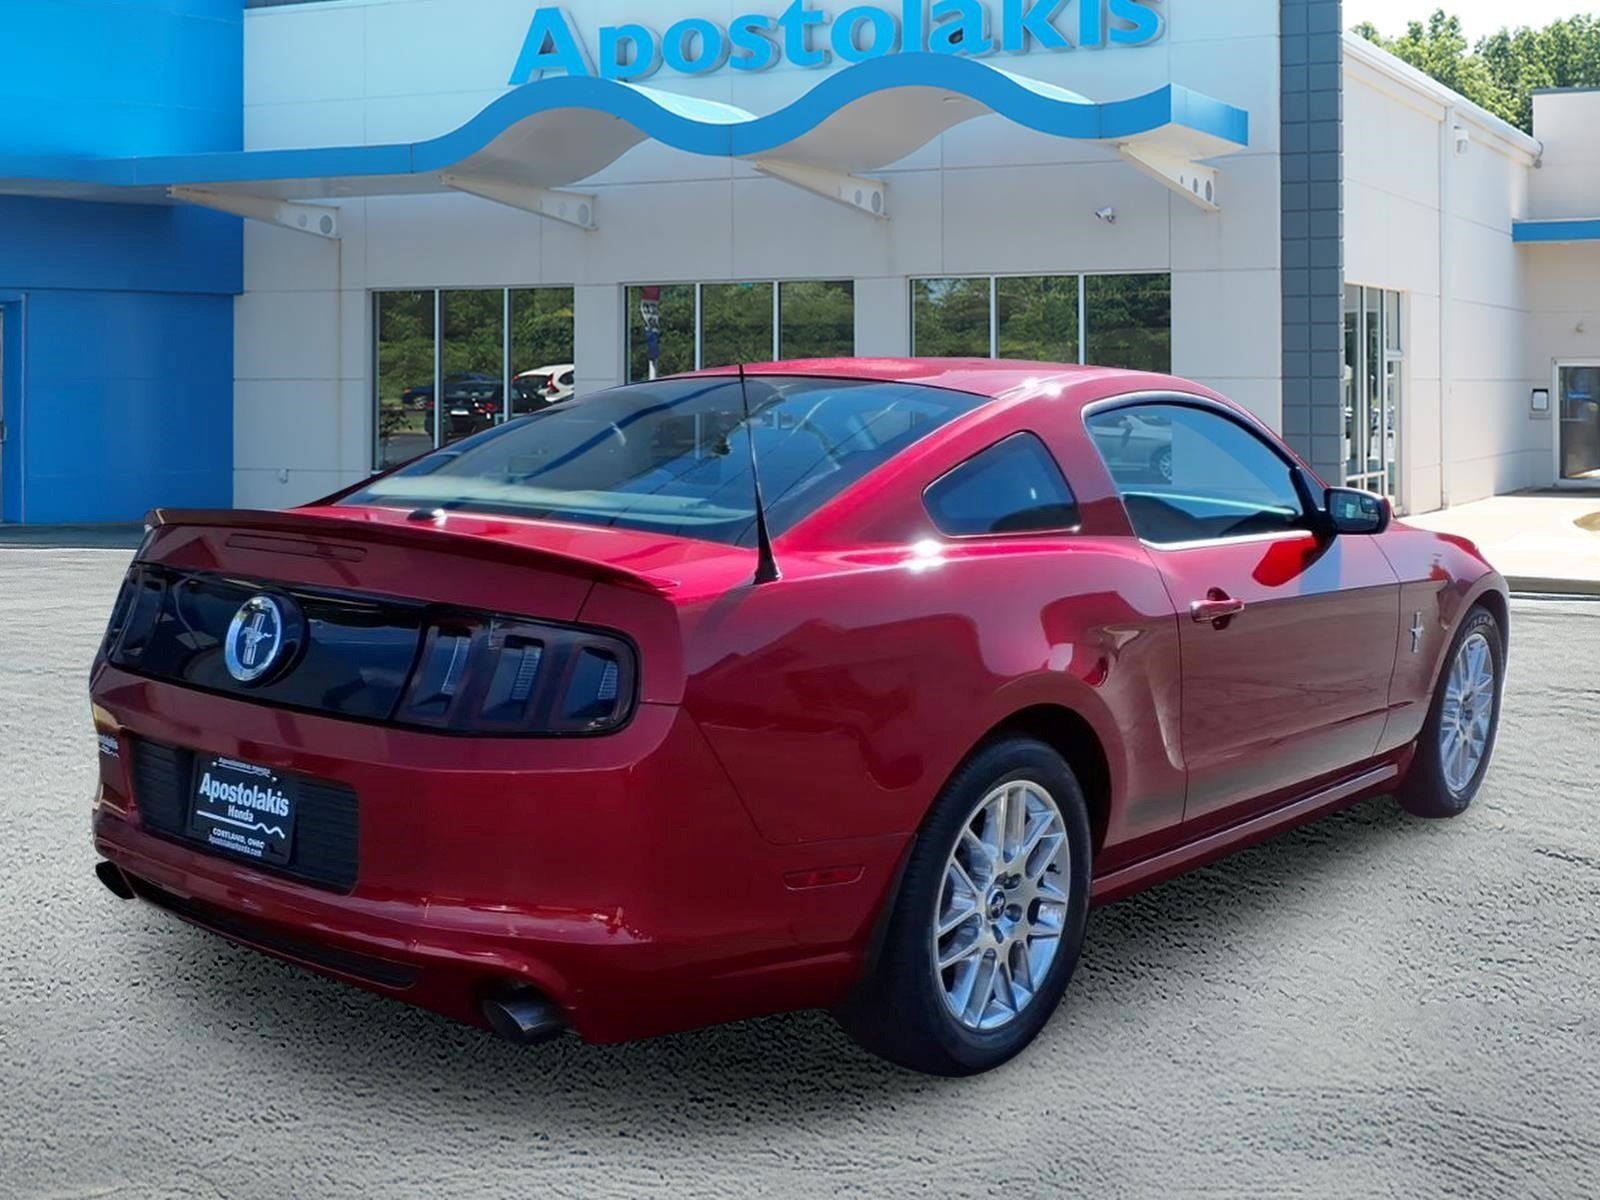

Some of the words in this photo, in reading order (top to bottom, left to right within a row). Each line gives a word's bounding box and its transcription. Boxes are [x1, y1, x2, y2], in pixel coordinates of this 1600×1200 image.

[508, 0, 1165, 85] Apostolakis
[199, 772, 290, 817] Apostolakis
[227, 805, 254, 822] Honda
